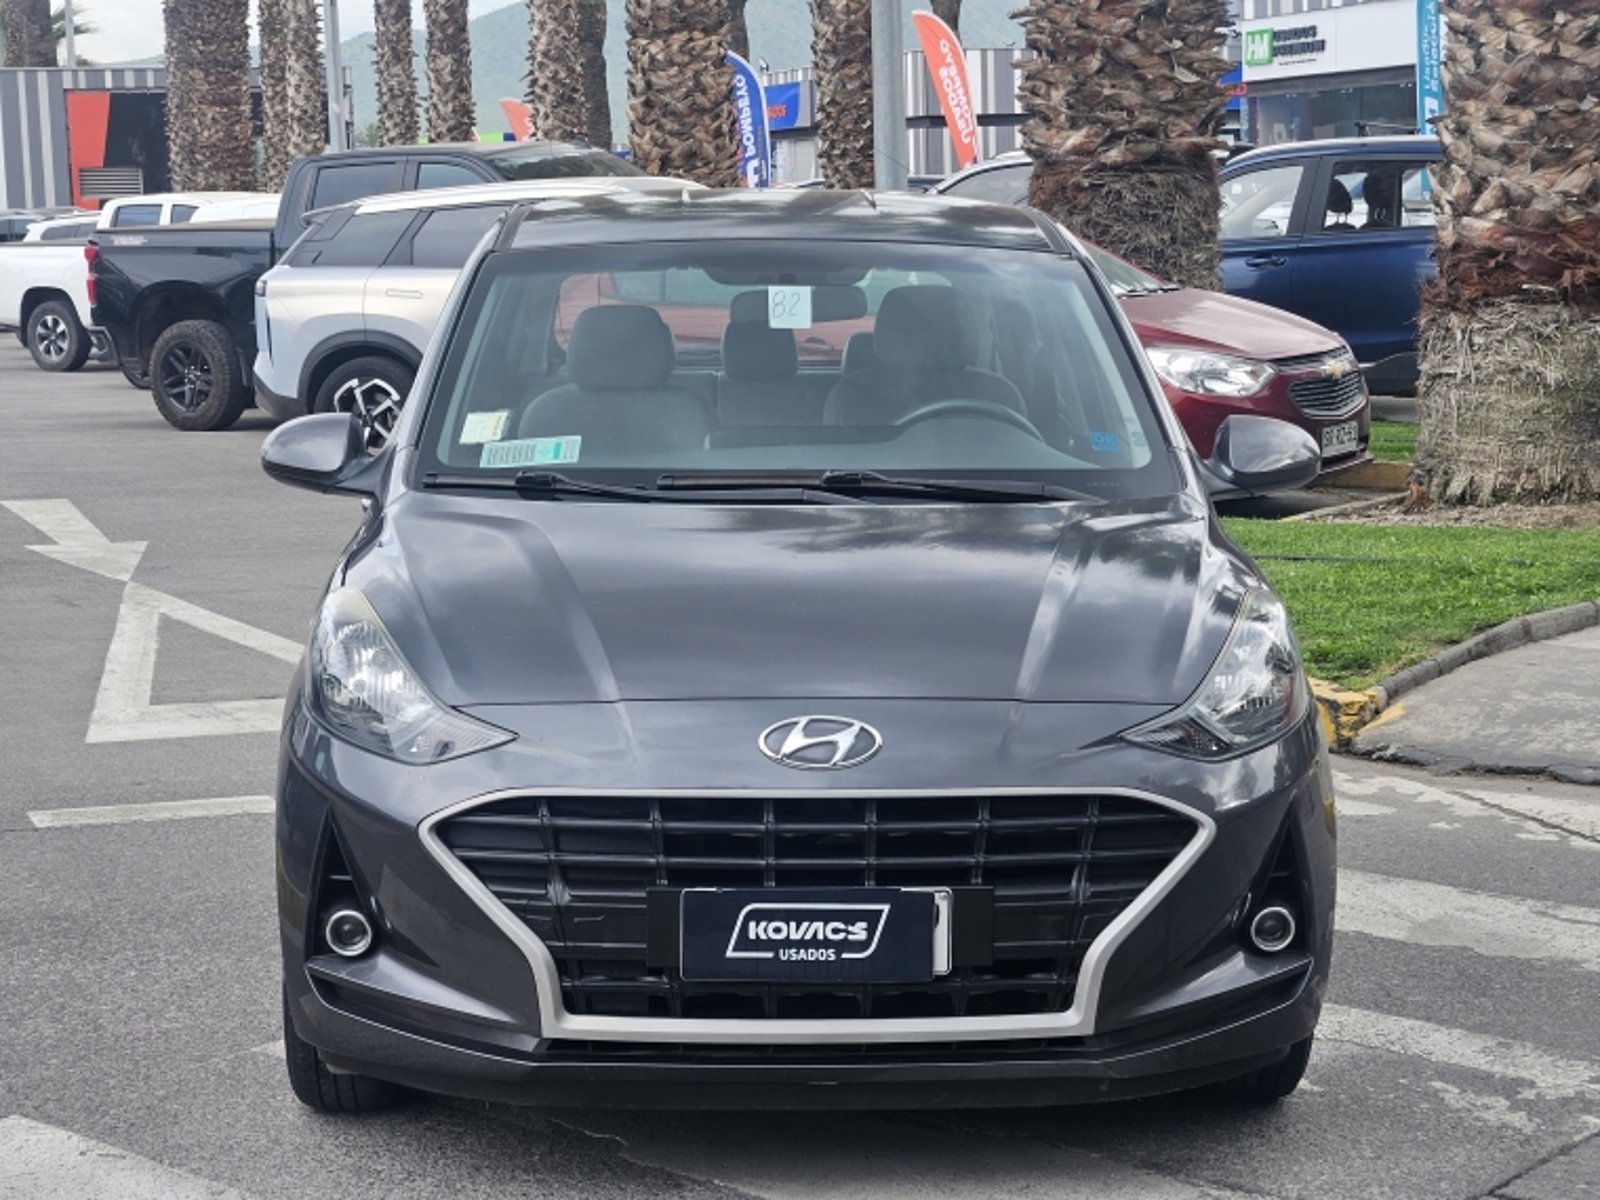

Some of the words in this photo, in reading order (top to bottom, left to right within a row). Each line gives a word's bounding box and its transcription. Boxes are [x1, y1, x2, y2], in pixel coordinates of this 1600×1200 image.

[1247, 33, 1270, 61] HM
[772, 290, 801, 318] 82
[748, 920, 868, 941] KOVACS
[779, 948, 836, 961] USADOS
